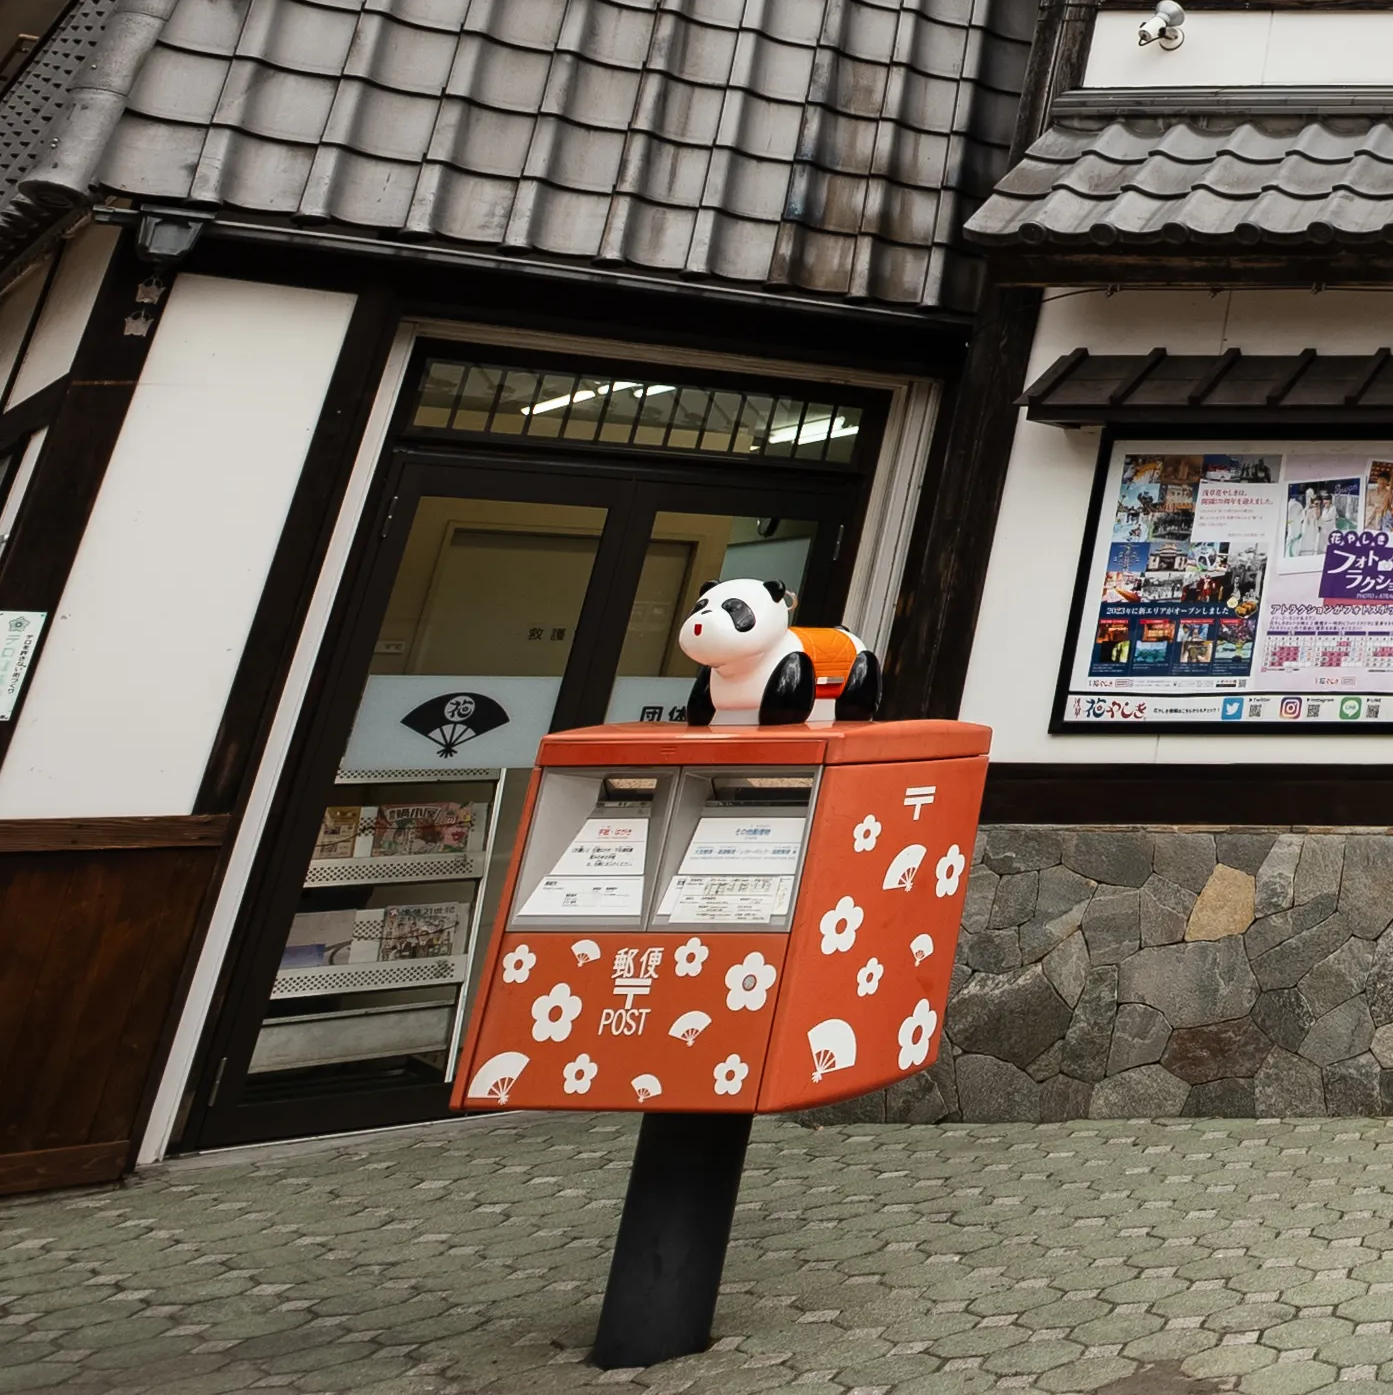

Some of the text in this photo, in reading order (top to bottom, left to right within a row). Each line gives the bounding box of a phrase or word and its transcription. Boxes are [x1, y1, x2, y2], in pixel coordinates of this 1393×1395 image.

[1330, 532, 1387, 546] 花やしき
[1327, 549, 1380, 574] フォト
[1106, 607, 1229, 616] 2023年に新エリアがオープンしました
[527, 627, 566, 642] 救護
[1085, 698, 1147, 719] 花やしき
[611, 947, 665, 980] 郵便
[597, 1008, 652, 1036] POST
